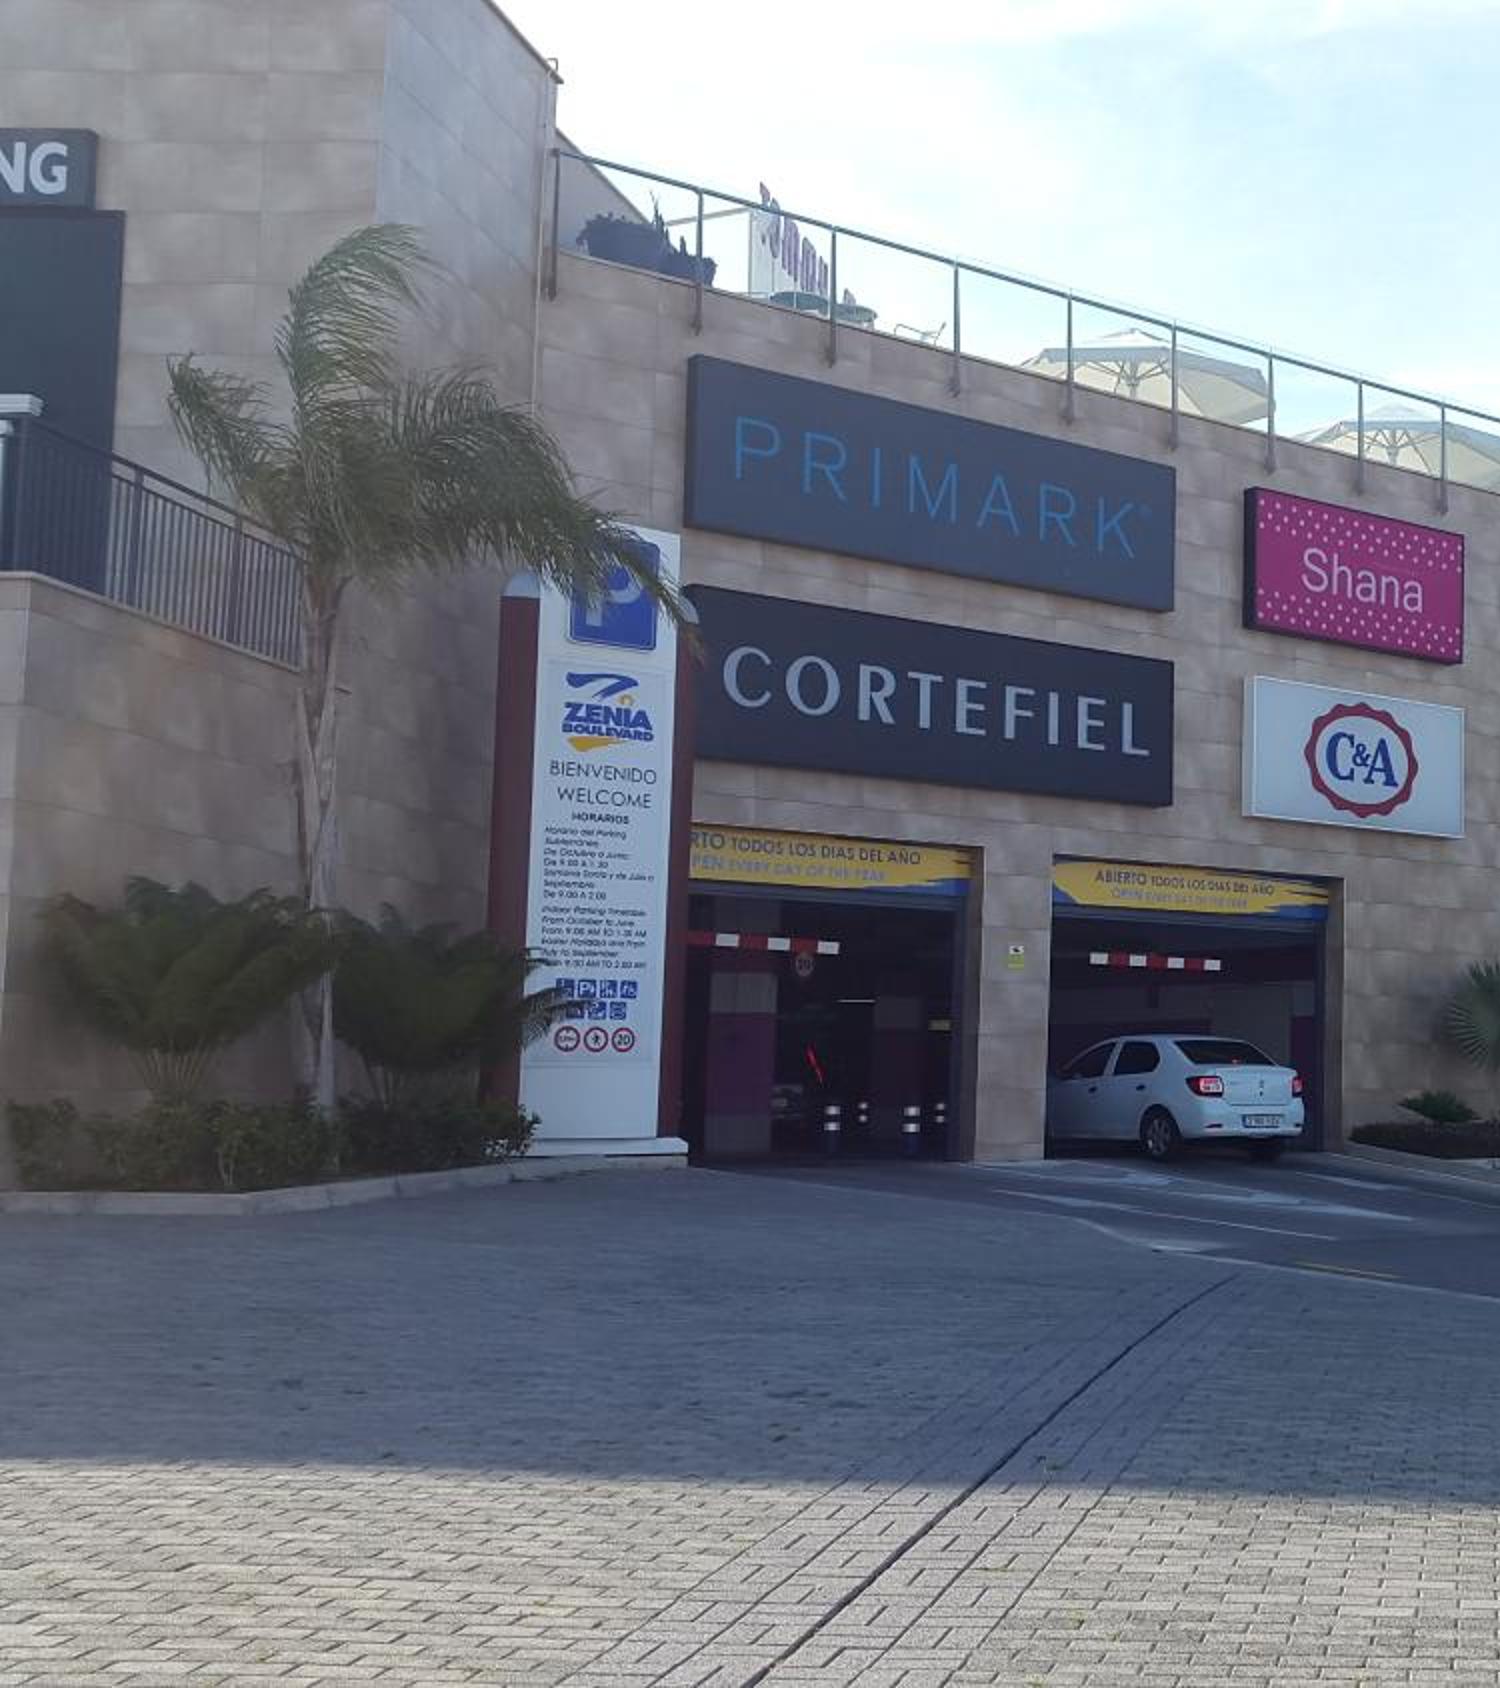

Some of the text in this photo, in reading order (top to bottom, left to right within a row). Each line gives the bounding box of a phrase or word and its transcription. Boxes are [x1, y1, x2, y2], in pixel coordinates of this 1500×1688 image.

[734, 416, 1135, 560] PRIMARK
[1301, 547, 1423, 613] Shana
[722, 645, 1150, 757] CORTEFIEL
[563, 702, 653, 730] ZENIA
[561, 723, 654, 742] BOULEVARD
[550, 760, 657, 785] BIENVENIDO
[1325, 731, 1399, 788] C&A
[557, 786, 652, 809] WELCOME
[572, 813, 630, 825] HORARIOS
[732, 836, 783, 856] TODOS
[789, 842, 816, 857] LOS
[859, 848, 884, 863] DEL
[887, 847, 921, 865] AÑO
[1094, 870, 1146, 885] ABIERTO
